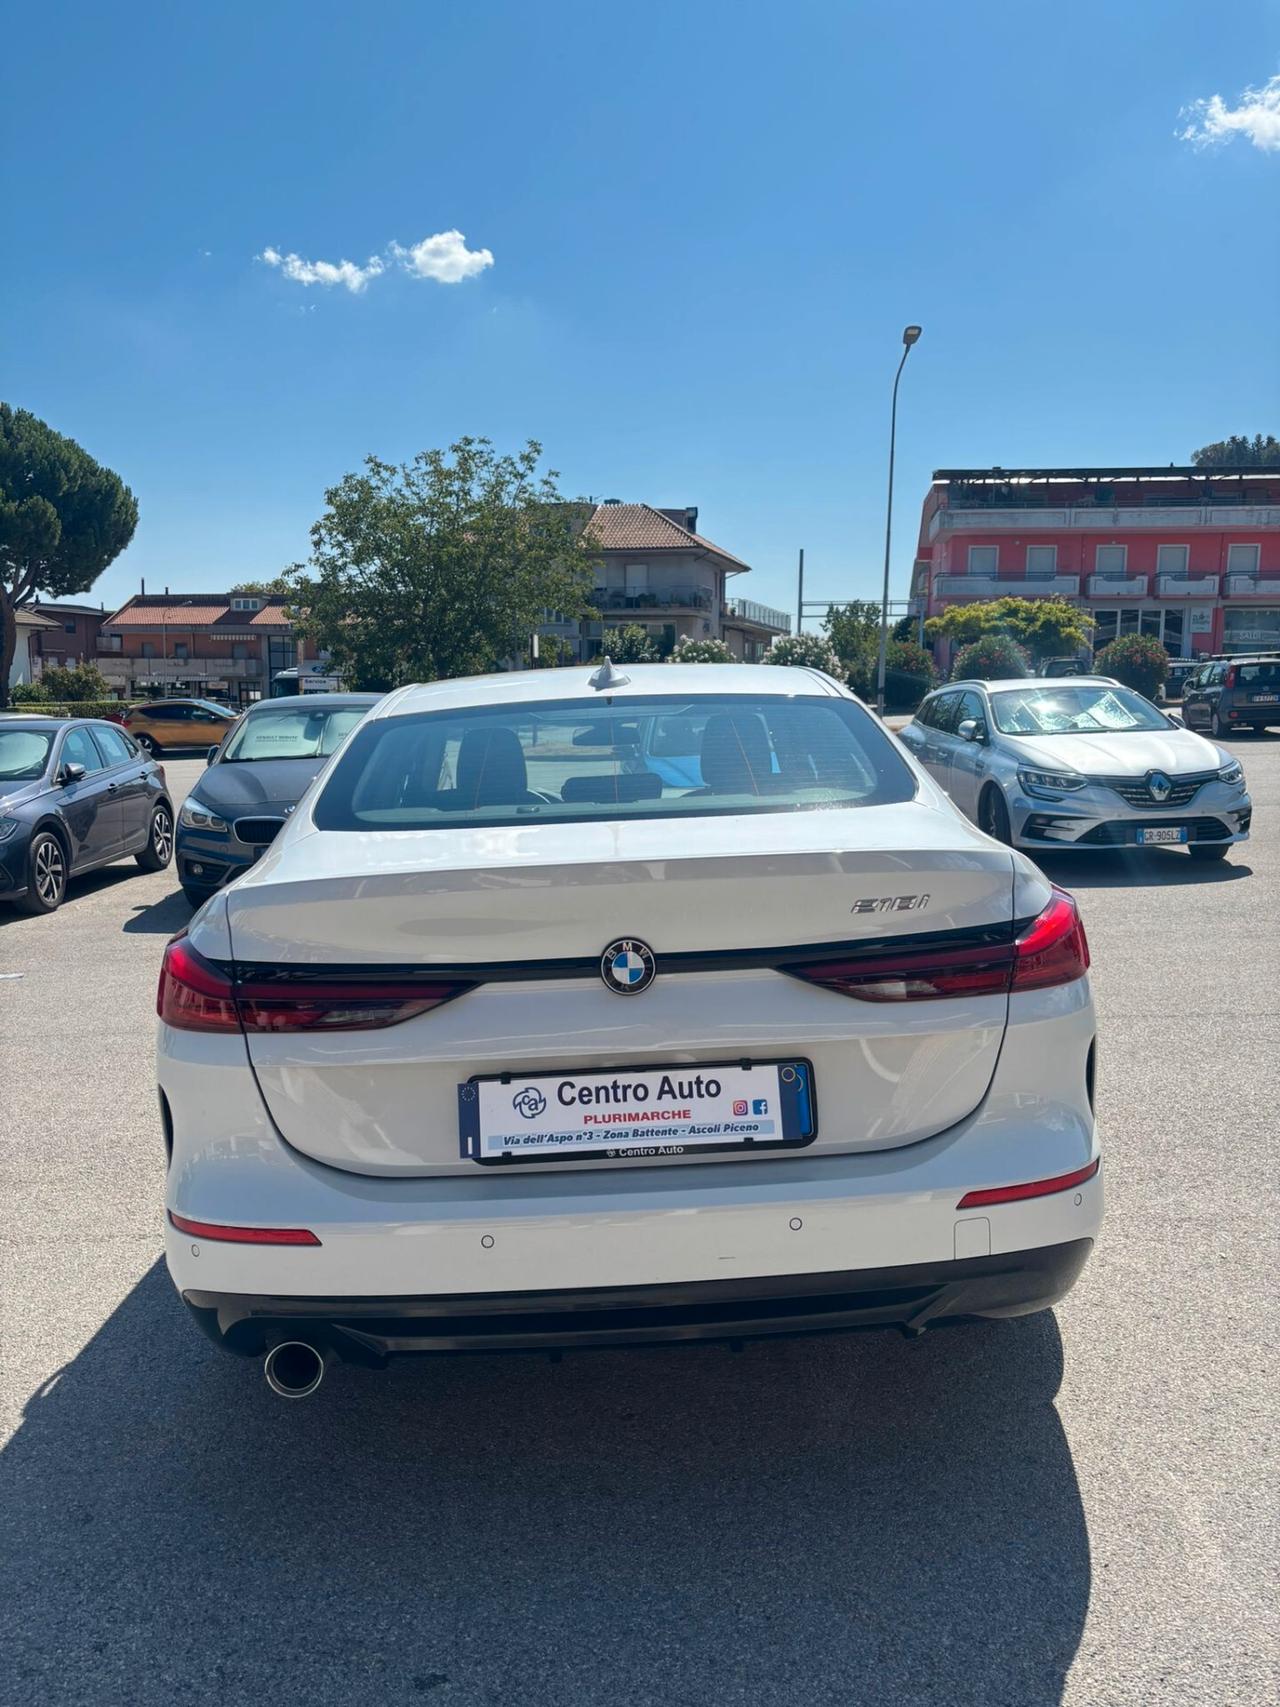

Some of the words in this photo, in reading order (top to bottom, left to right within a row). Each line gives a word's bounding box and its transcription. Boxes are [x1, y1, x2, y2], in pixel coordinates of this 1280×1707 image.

[607, 942, 650, 960] BMW
[557, 1079, 649, 1106] Centro
[657, 1075, 722, 1101] Auto
[584, 1110, 691, 1125] PLURIMARCHE
[503, 1135, 522, 1146] Via
[523, 1131, 574, 1146] dell'Aspo
[603, 1128, 629, 1140] Zona
[632, 1125, 678, 1138] Battente
[689, 1123, 721, 1135] Ascoli
[723, 1121, 759, 1134] Piceno
[619, 1145, 655, 1157] Centro
[658, 1144, 684, 1155] Auto
